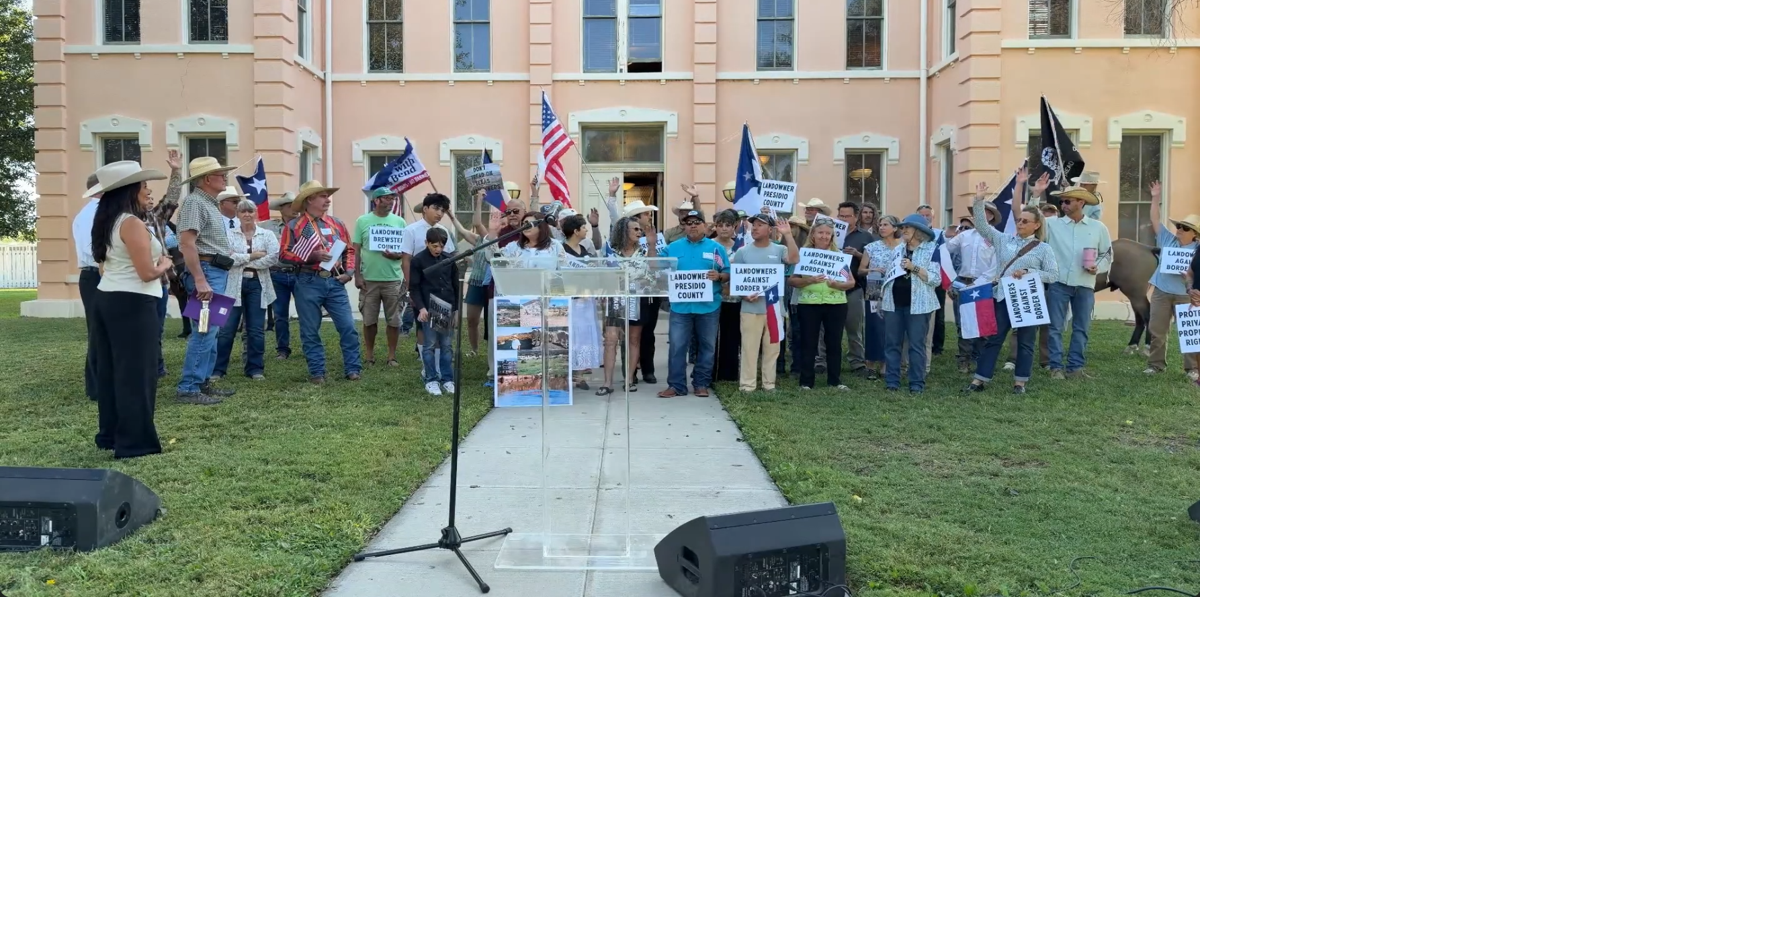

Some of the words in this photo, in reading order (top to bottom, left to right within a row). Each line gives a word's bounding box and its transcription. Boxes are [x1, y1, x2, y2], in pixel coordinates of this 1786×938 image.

[394, 157, 415, 173] with
[391, 166, 416, 183] Bend
[762, 182, 795, 192] LANDOWNER
[763, 191, 789, 200] PRESIDIO
[763, 199, 785, 208] COUNTY
[803, 250, 845, 263] LANDOWNERS
[1167, 250, 1194, 258] LANDOW
[808, 259, 836, 269] AGAINST
[735, 267, 777, 275] LANDOWNERS
[800, 265, 825, 274] BORDER
[826, 269, 843, 277] WALL
[674, 282, 707, 290] PRESIDIO
[1027, 277, 1038, 295] WALL
[677, 291, 704, 299] COUNTY
[1007, 282, 1023, 323] LANDOWNERS
[1019, 288, 1032, 314] AGAINST
[1031, 295, 1044, 320] BORDER
[1178, 310, 1200, 318] PROT
[1181, 319, 1200, 327] PRIV
[1178, 329, 1200, 337] PROP
[1185, 338, 1200, 346] RIG
